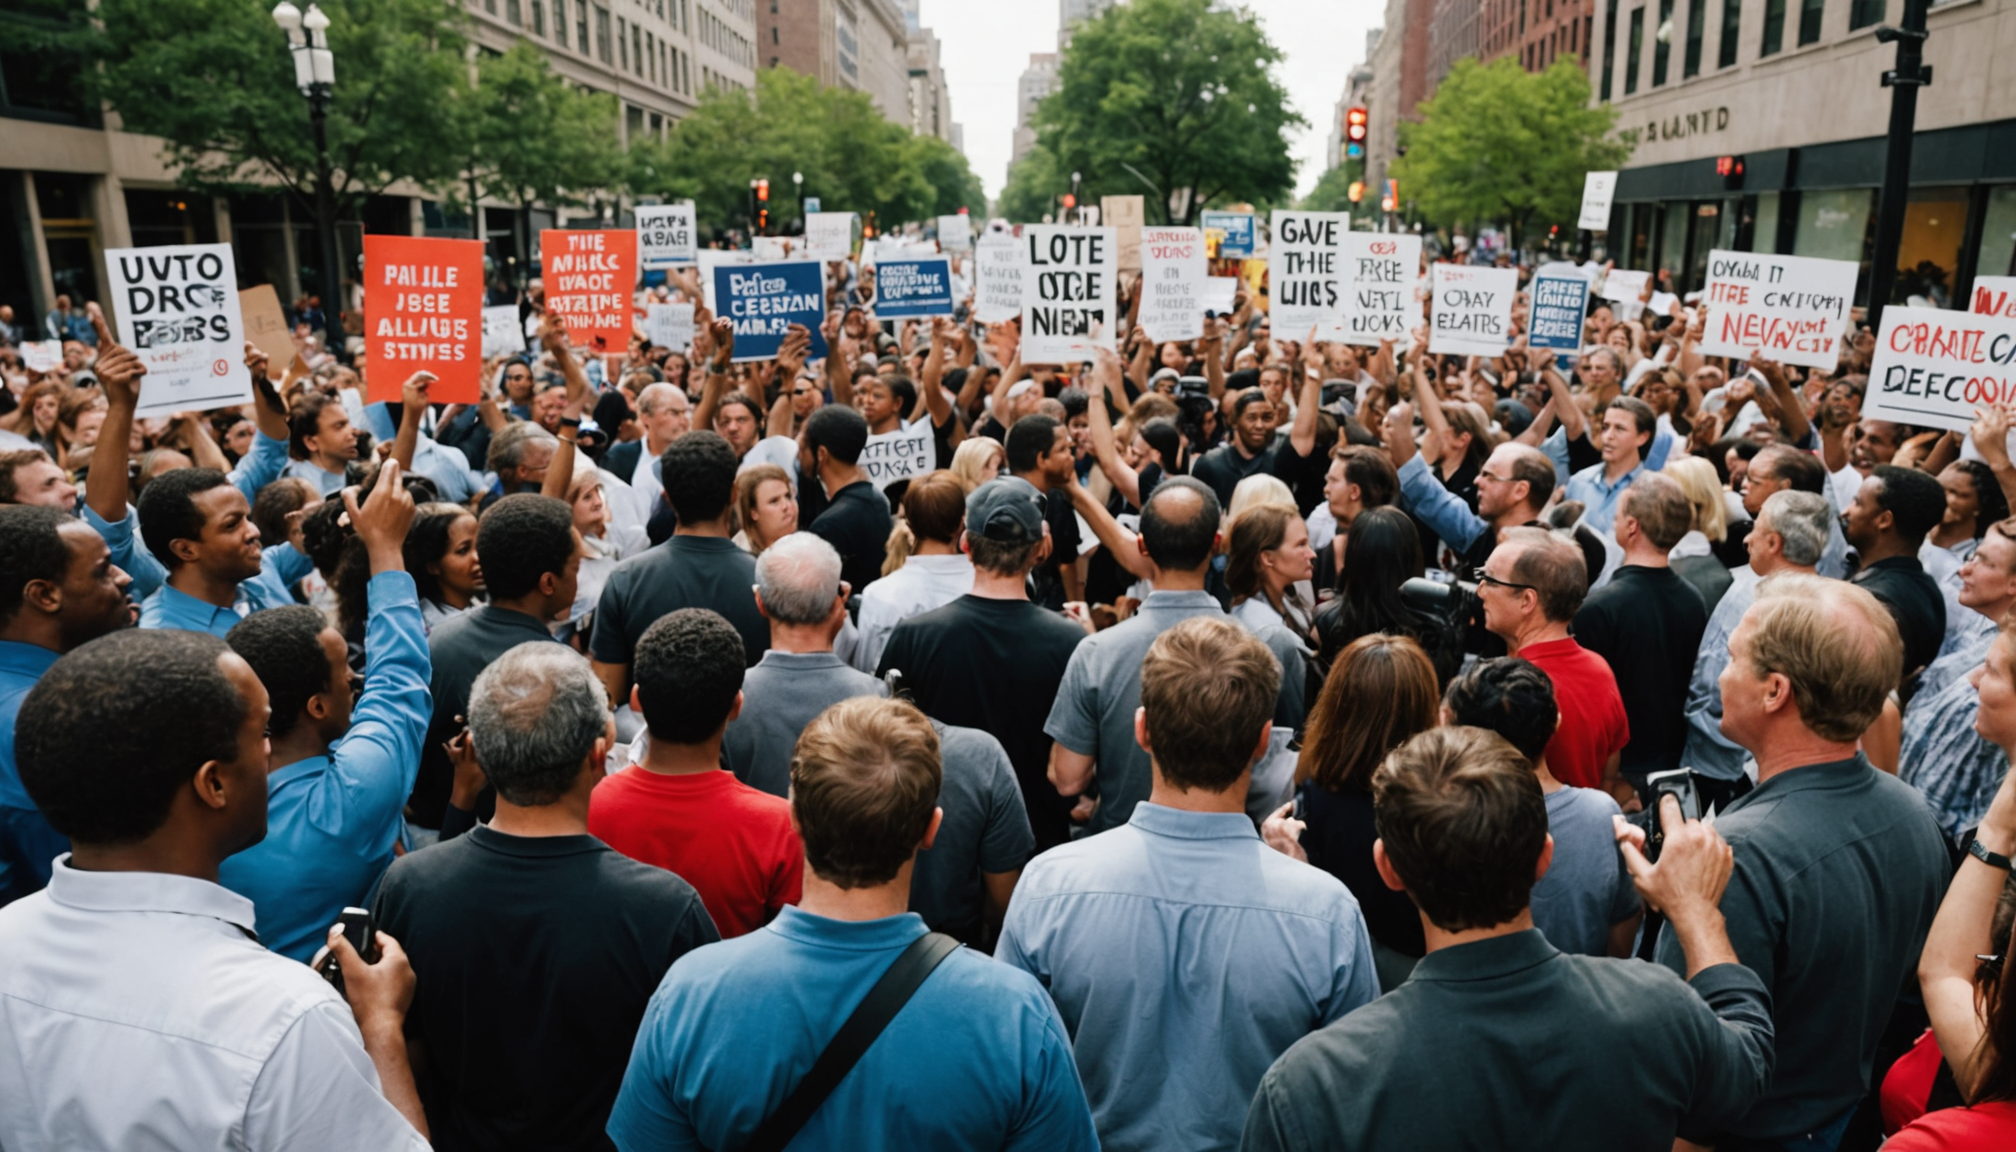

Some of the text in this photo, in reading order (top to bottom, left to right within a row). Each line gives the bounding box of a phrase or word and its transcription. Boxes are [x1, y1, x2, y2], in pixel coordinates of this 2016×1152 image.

[1280, 217, 1339, 246] GAVE
[1029, 233, 1104, 266] LOTE
[119, 253, 223, 284] UVTO
